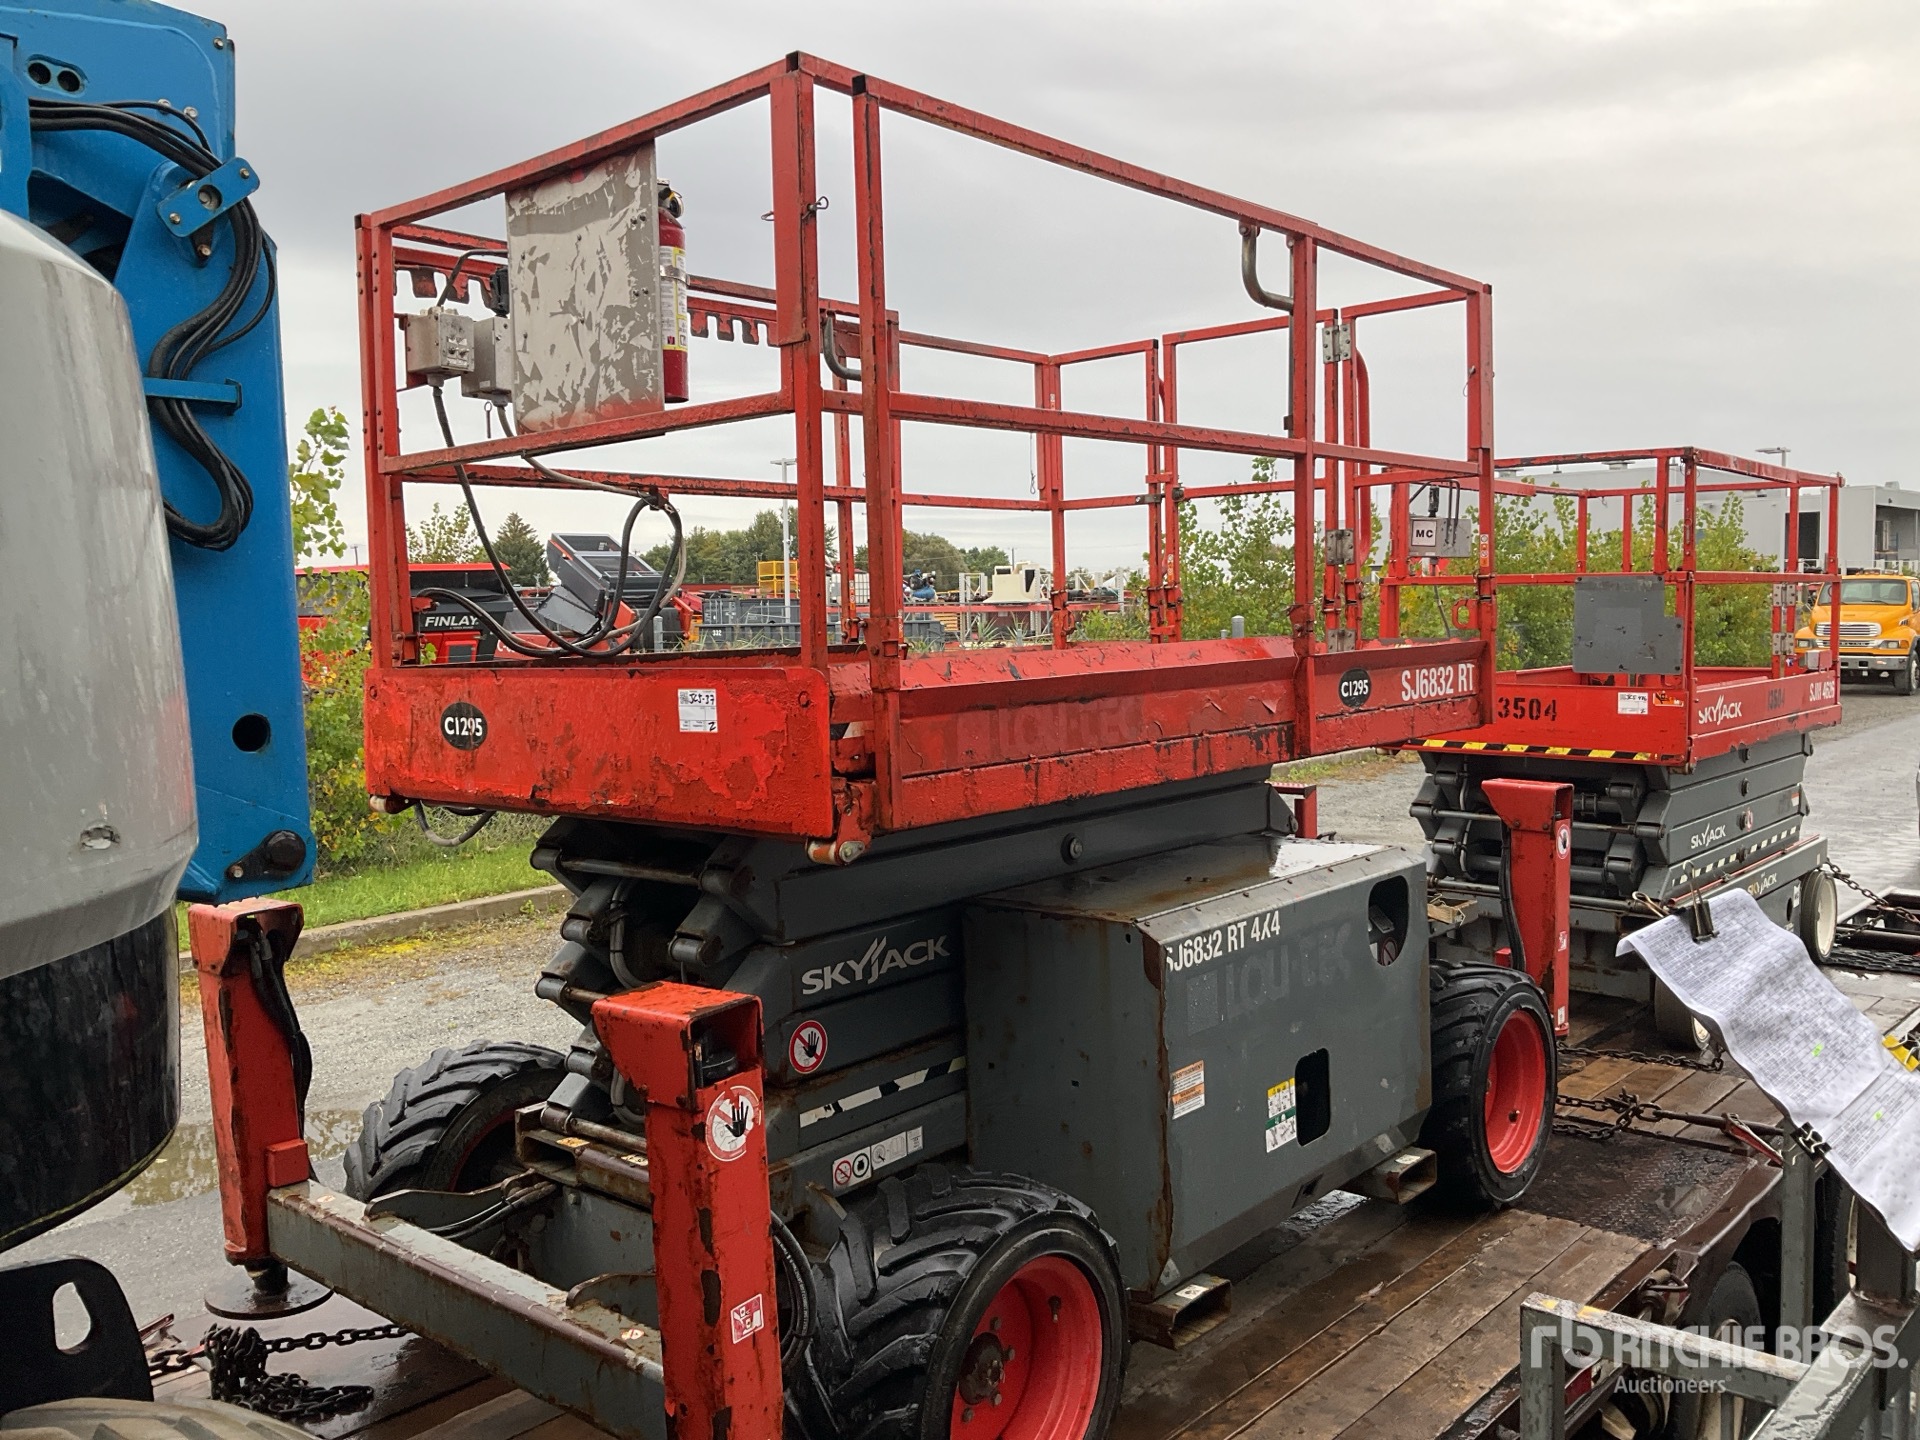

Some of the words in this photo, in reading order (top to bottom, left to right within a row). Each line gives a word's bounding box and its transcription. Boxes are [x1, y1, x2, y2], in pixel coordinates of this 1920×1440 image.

[1415, 529, 1434, 538] MC
[424, 615, 478, 628] FINLAY
[1340, 679, 1369, 697] C1295
[1401, 666, 1454, 701] SJ6832
[1458, 663, 1475, 692] RT
[1698, 694, 1742, 725] SKYJACK
[444, 716, 483, 737] C1295
[1690, 823, 1726, 849] SKYJACK
[1166, 930, 1222, 972] SJ6832
[1228, 921, 1247, 952] RT
[1250, 910, 1281, 942] 4X4
[801, 935, 950, 995] SKYJACK
